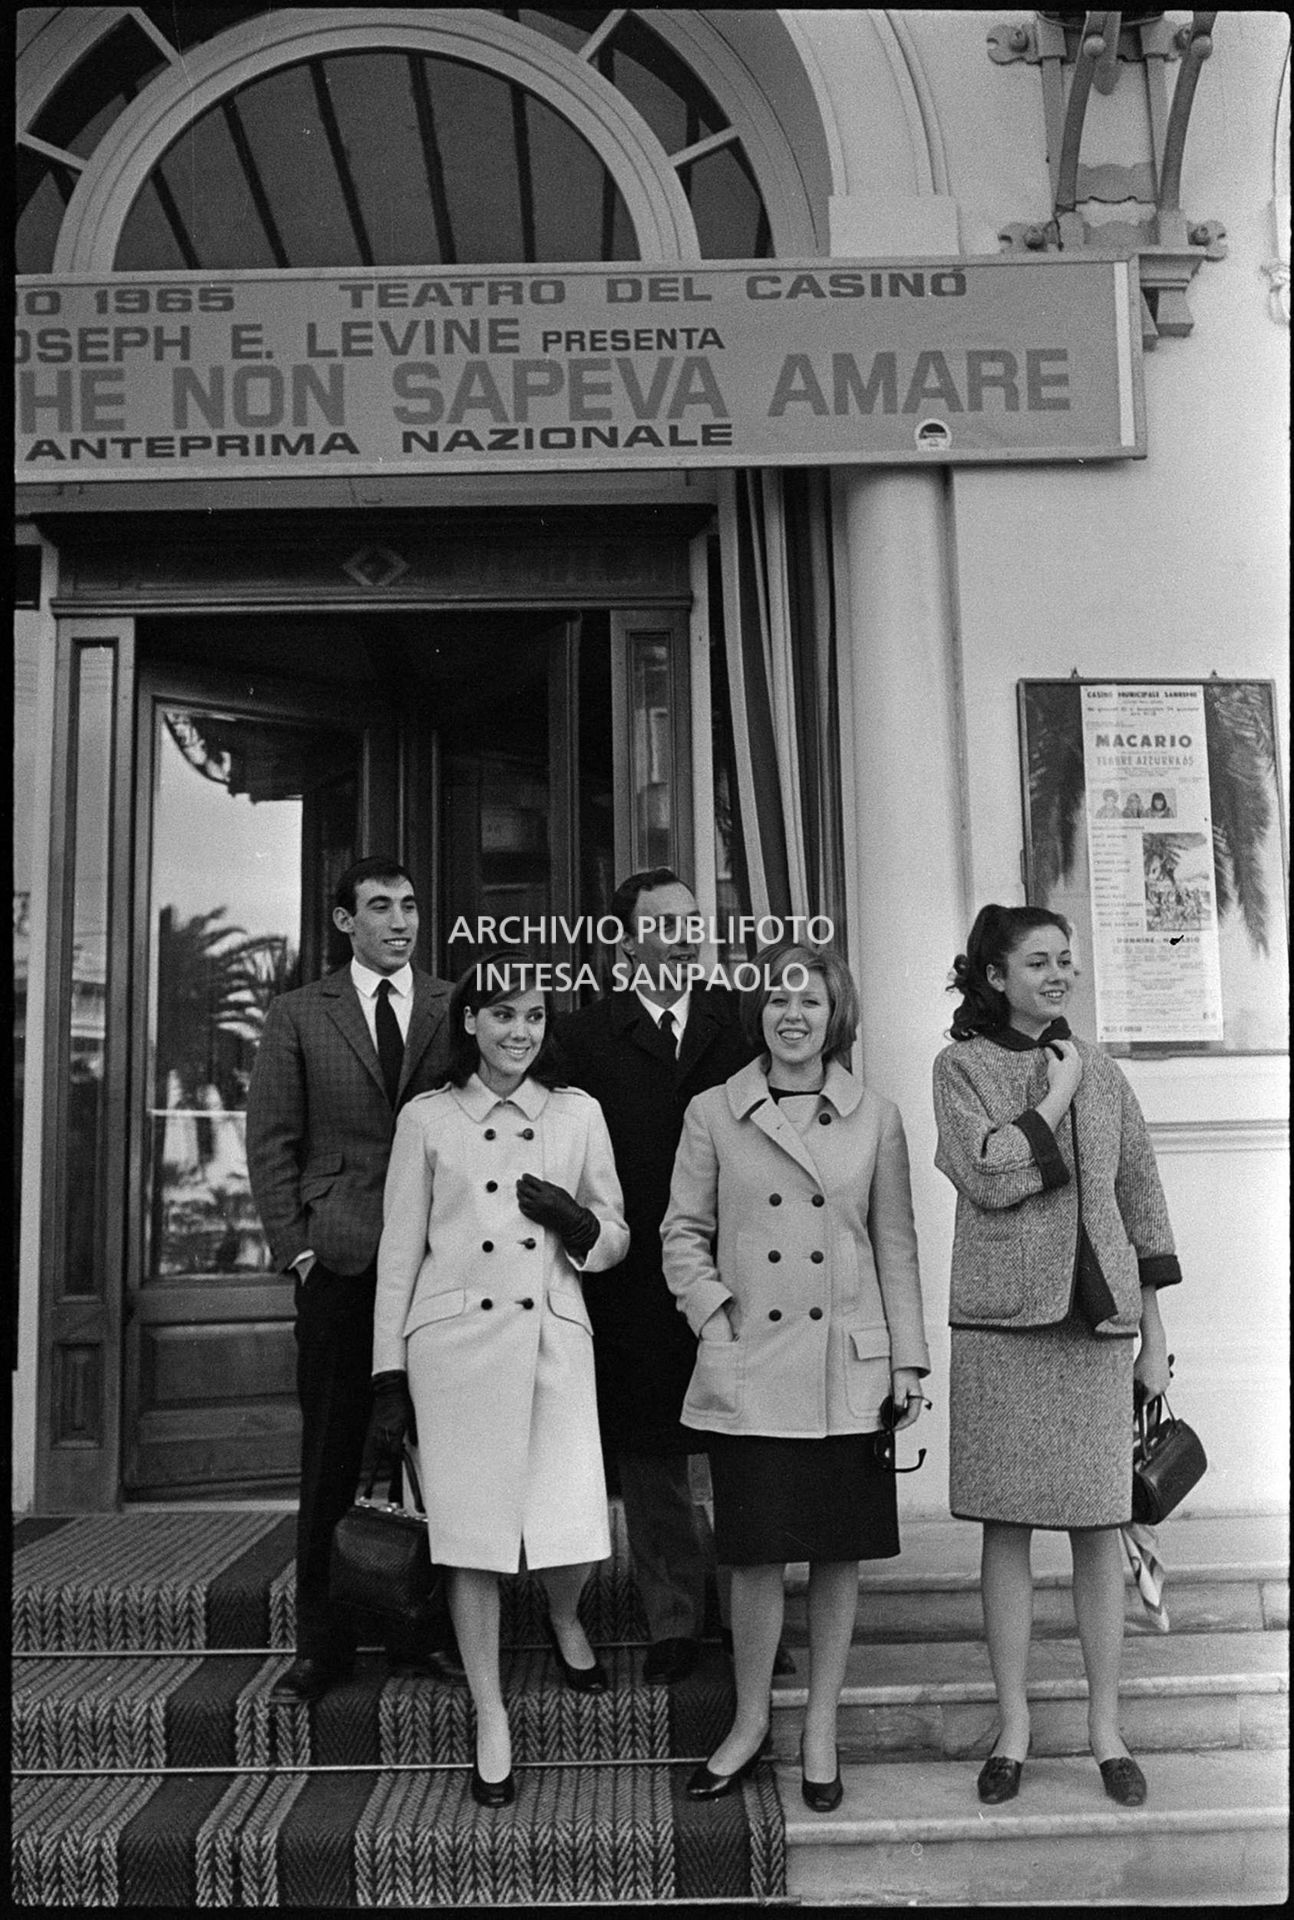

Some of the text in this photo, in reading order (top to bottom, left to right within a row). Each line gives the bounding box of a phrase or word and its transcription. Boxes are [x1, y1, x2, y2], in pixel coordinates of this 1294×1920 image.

[95, 285, 236, 316] 1965
[338, 278, 567, 309] TEATRO
[605, 275, 713, 304] DEL
[231, 323, 274, 361] E.
[306, 317, 521, 360] LEVINE
[542, 327, 726, 353] PRESENTA
[16, 348, 1071, 435] HE NON SAPEVA AMARE
[24, 423, 733, 463] ANTEPRIMA NAZIONALE
[1095, 734, 1192, 748] MACARIO
